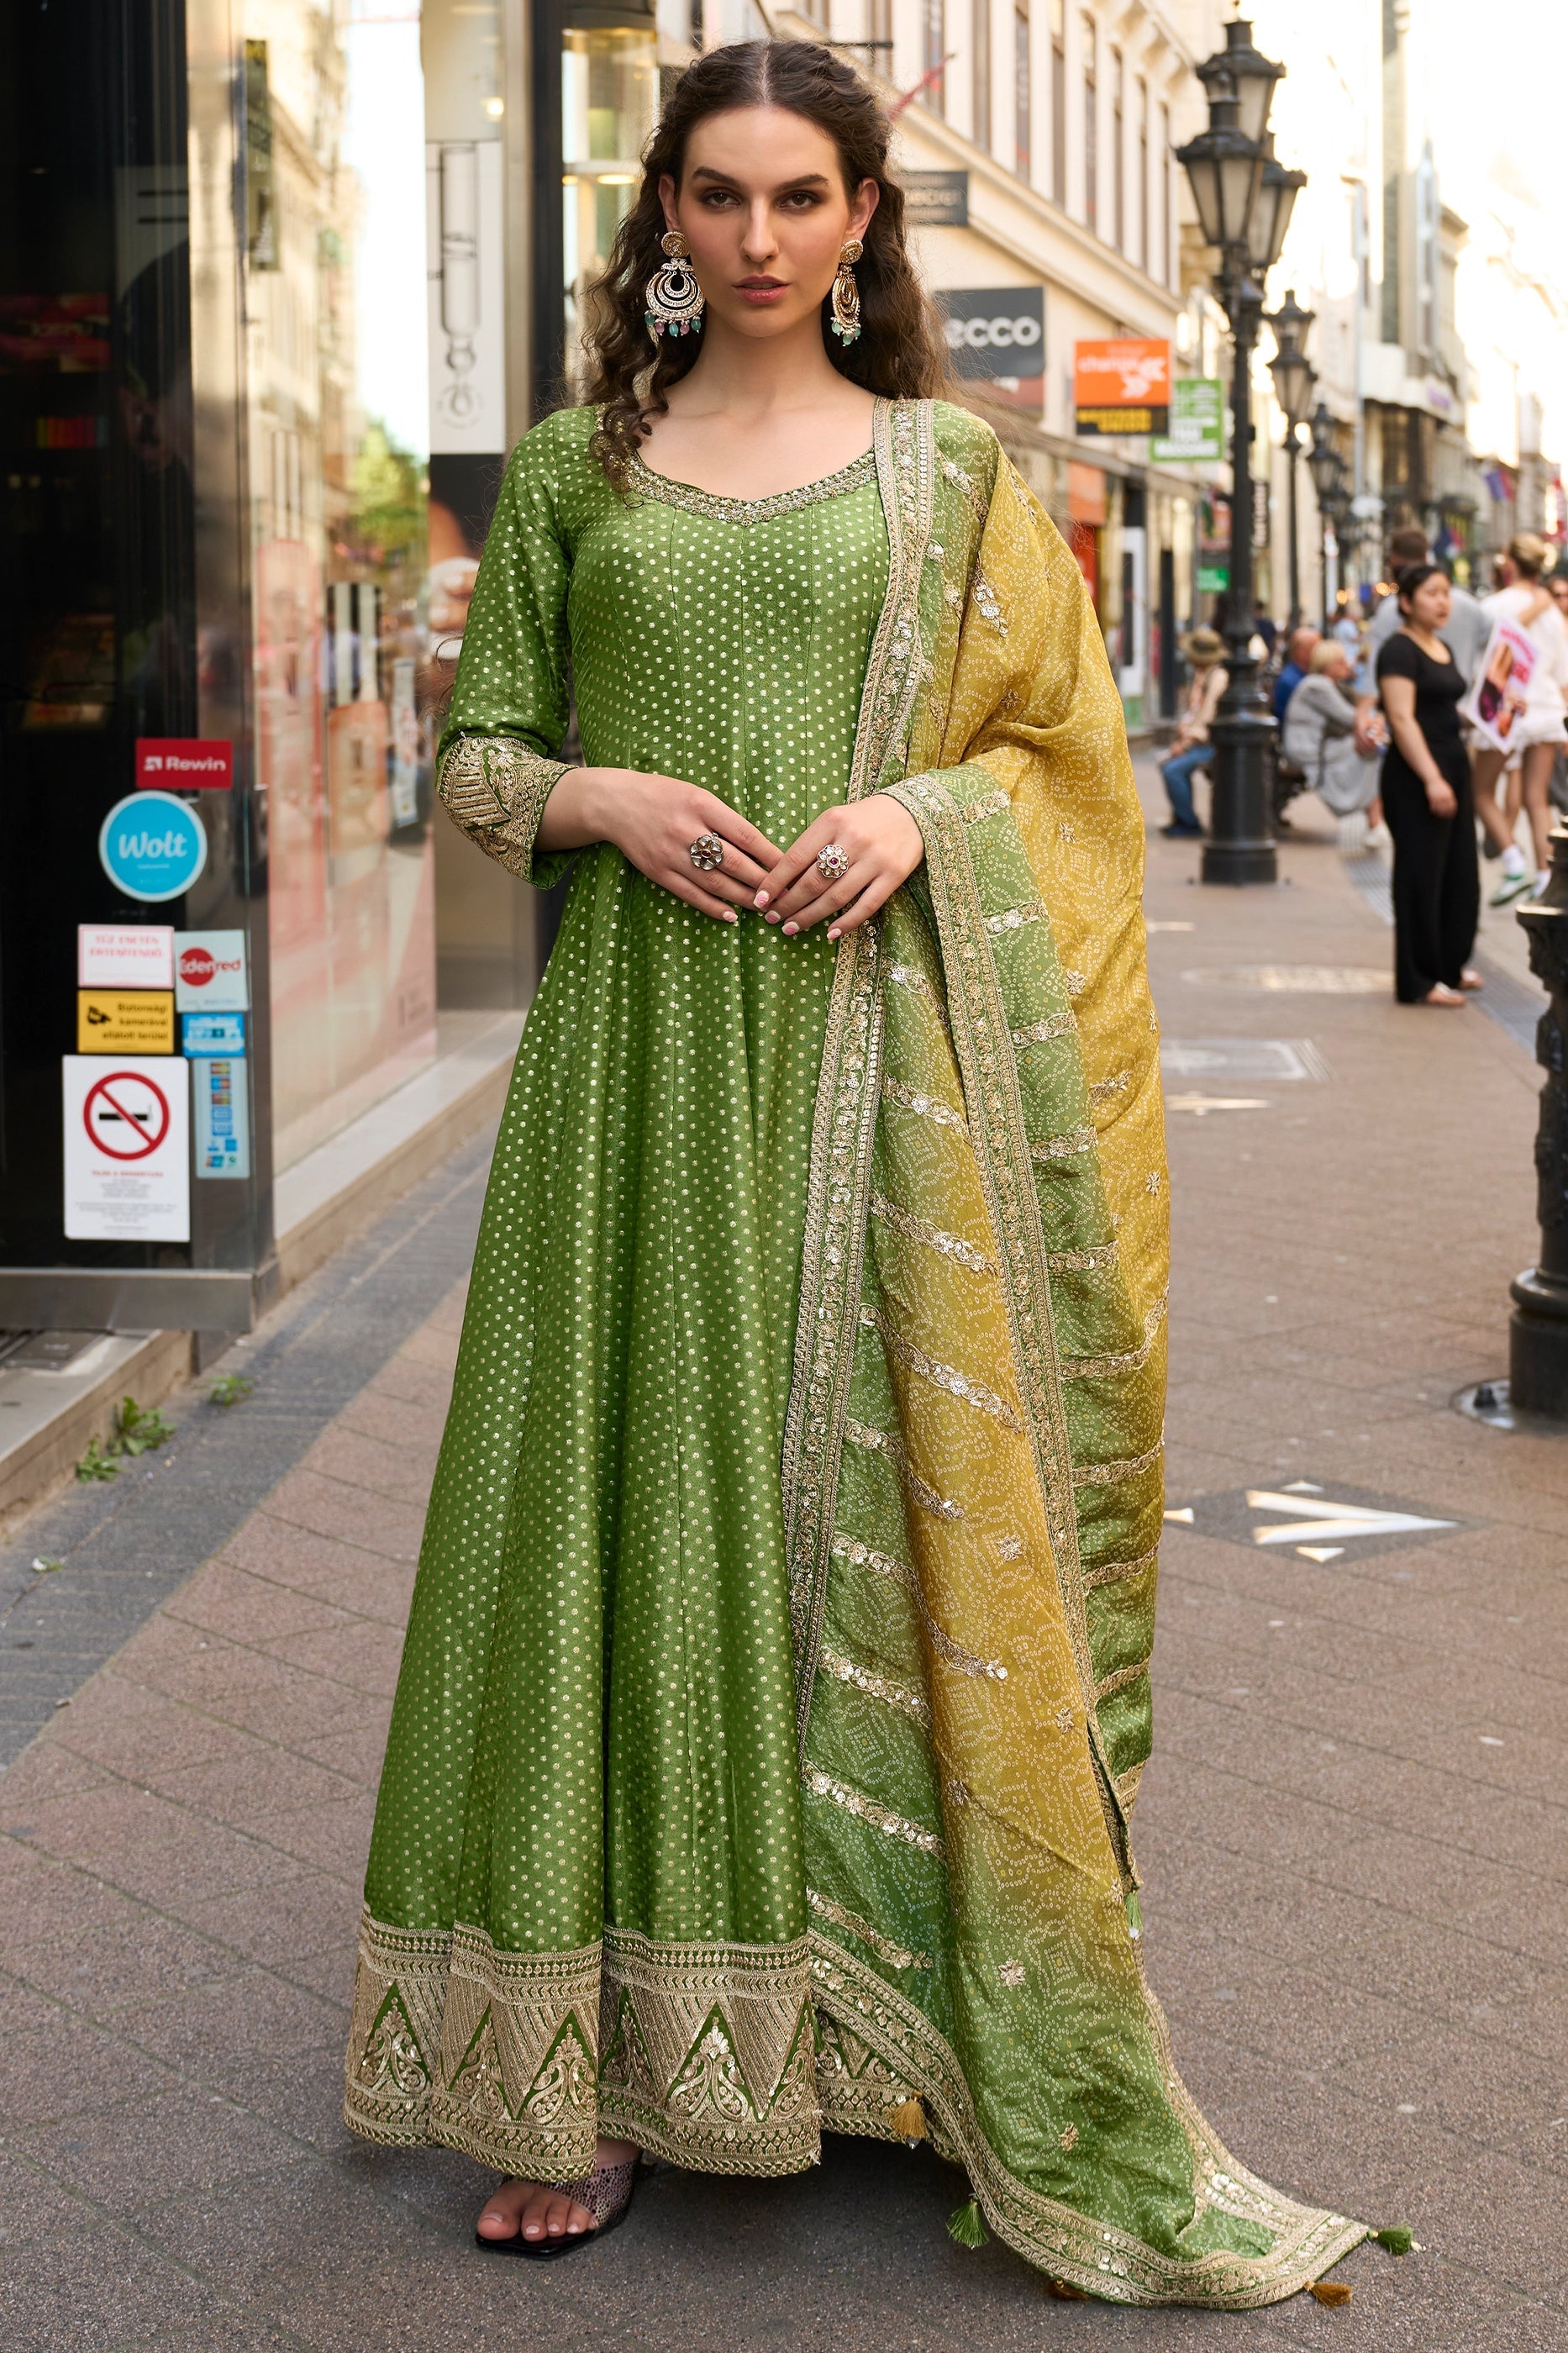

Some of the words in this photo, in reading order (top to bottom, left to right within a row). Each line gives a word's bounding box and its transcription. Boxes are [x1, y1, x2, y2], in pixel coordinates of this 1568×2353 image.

[943, 316, 1041, 349] ecco
[166, 755, 226, 771] Rewin
[118, 830, 187, 859] Wolt
[180, 956, 241, 975] Edenred
